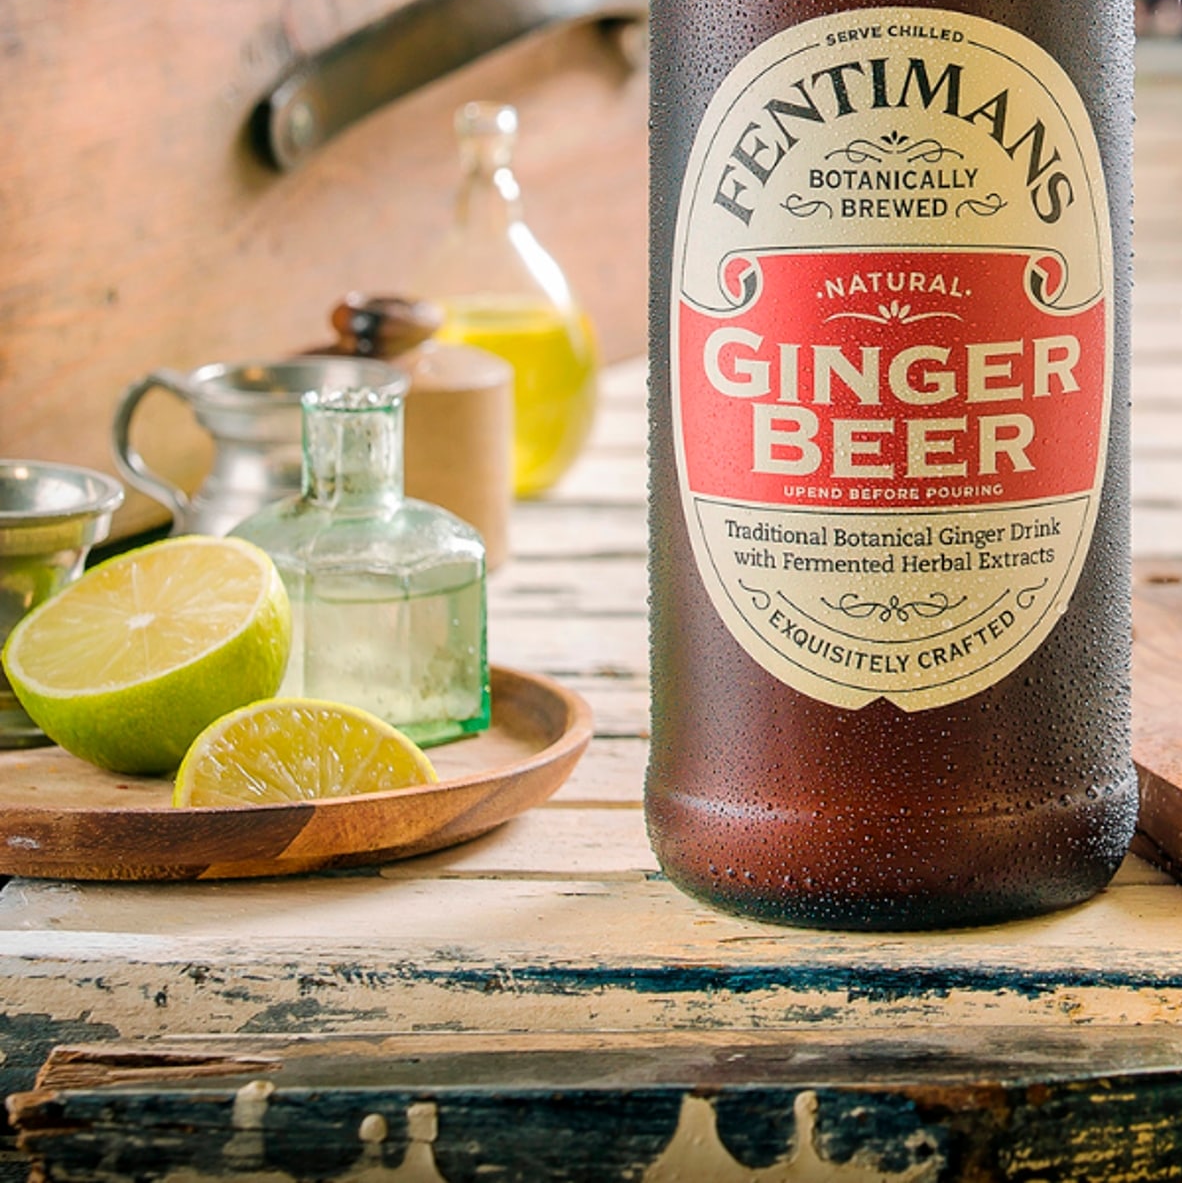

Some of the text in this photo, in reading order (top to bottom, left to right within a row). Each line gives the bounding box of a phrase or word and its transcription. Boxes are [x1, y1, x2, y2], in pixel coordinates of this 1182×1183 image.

[826, 24, 965, 47] SERVE CHILLED
[713, 57, 1075, 227] FENTIMANS
[809, 168, 978, 191] BOTANICALLY
[842, 198, 947, 219] BREWED
[703, 326, 1081, 406] GINGER
[750, 403, 1036, 479] BEER
[783, 484, 1004, 501] UPEND BEFORE POURING
[725, 517, 1061, 549] Traditional Botanical Ginger Drink
[734, 547, 1055, 573] with Fermented Herbal Extracts
[768, 609, 1015, 674] EXQUISITELY CRAFTED
